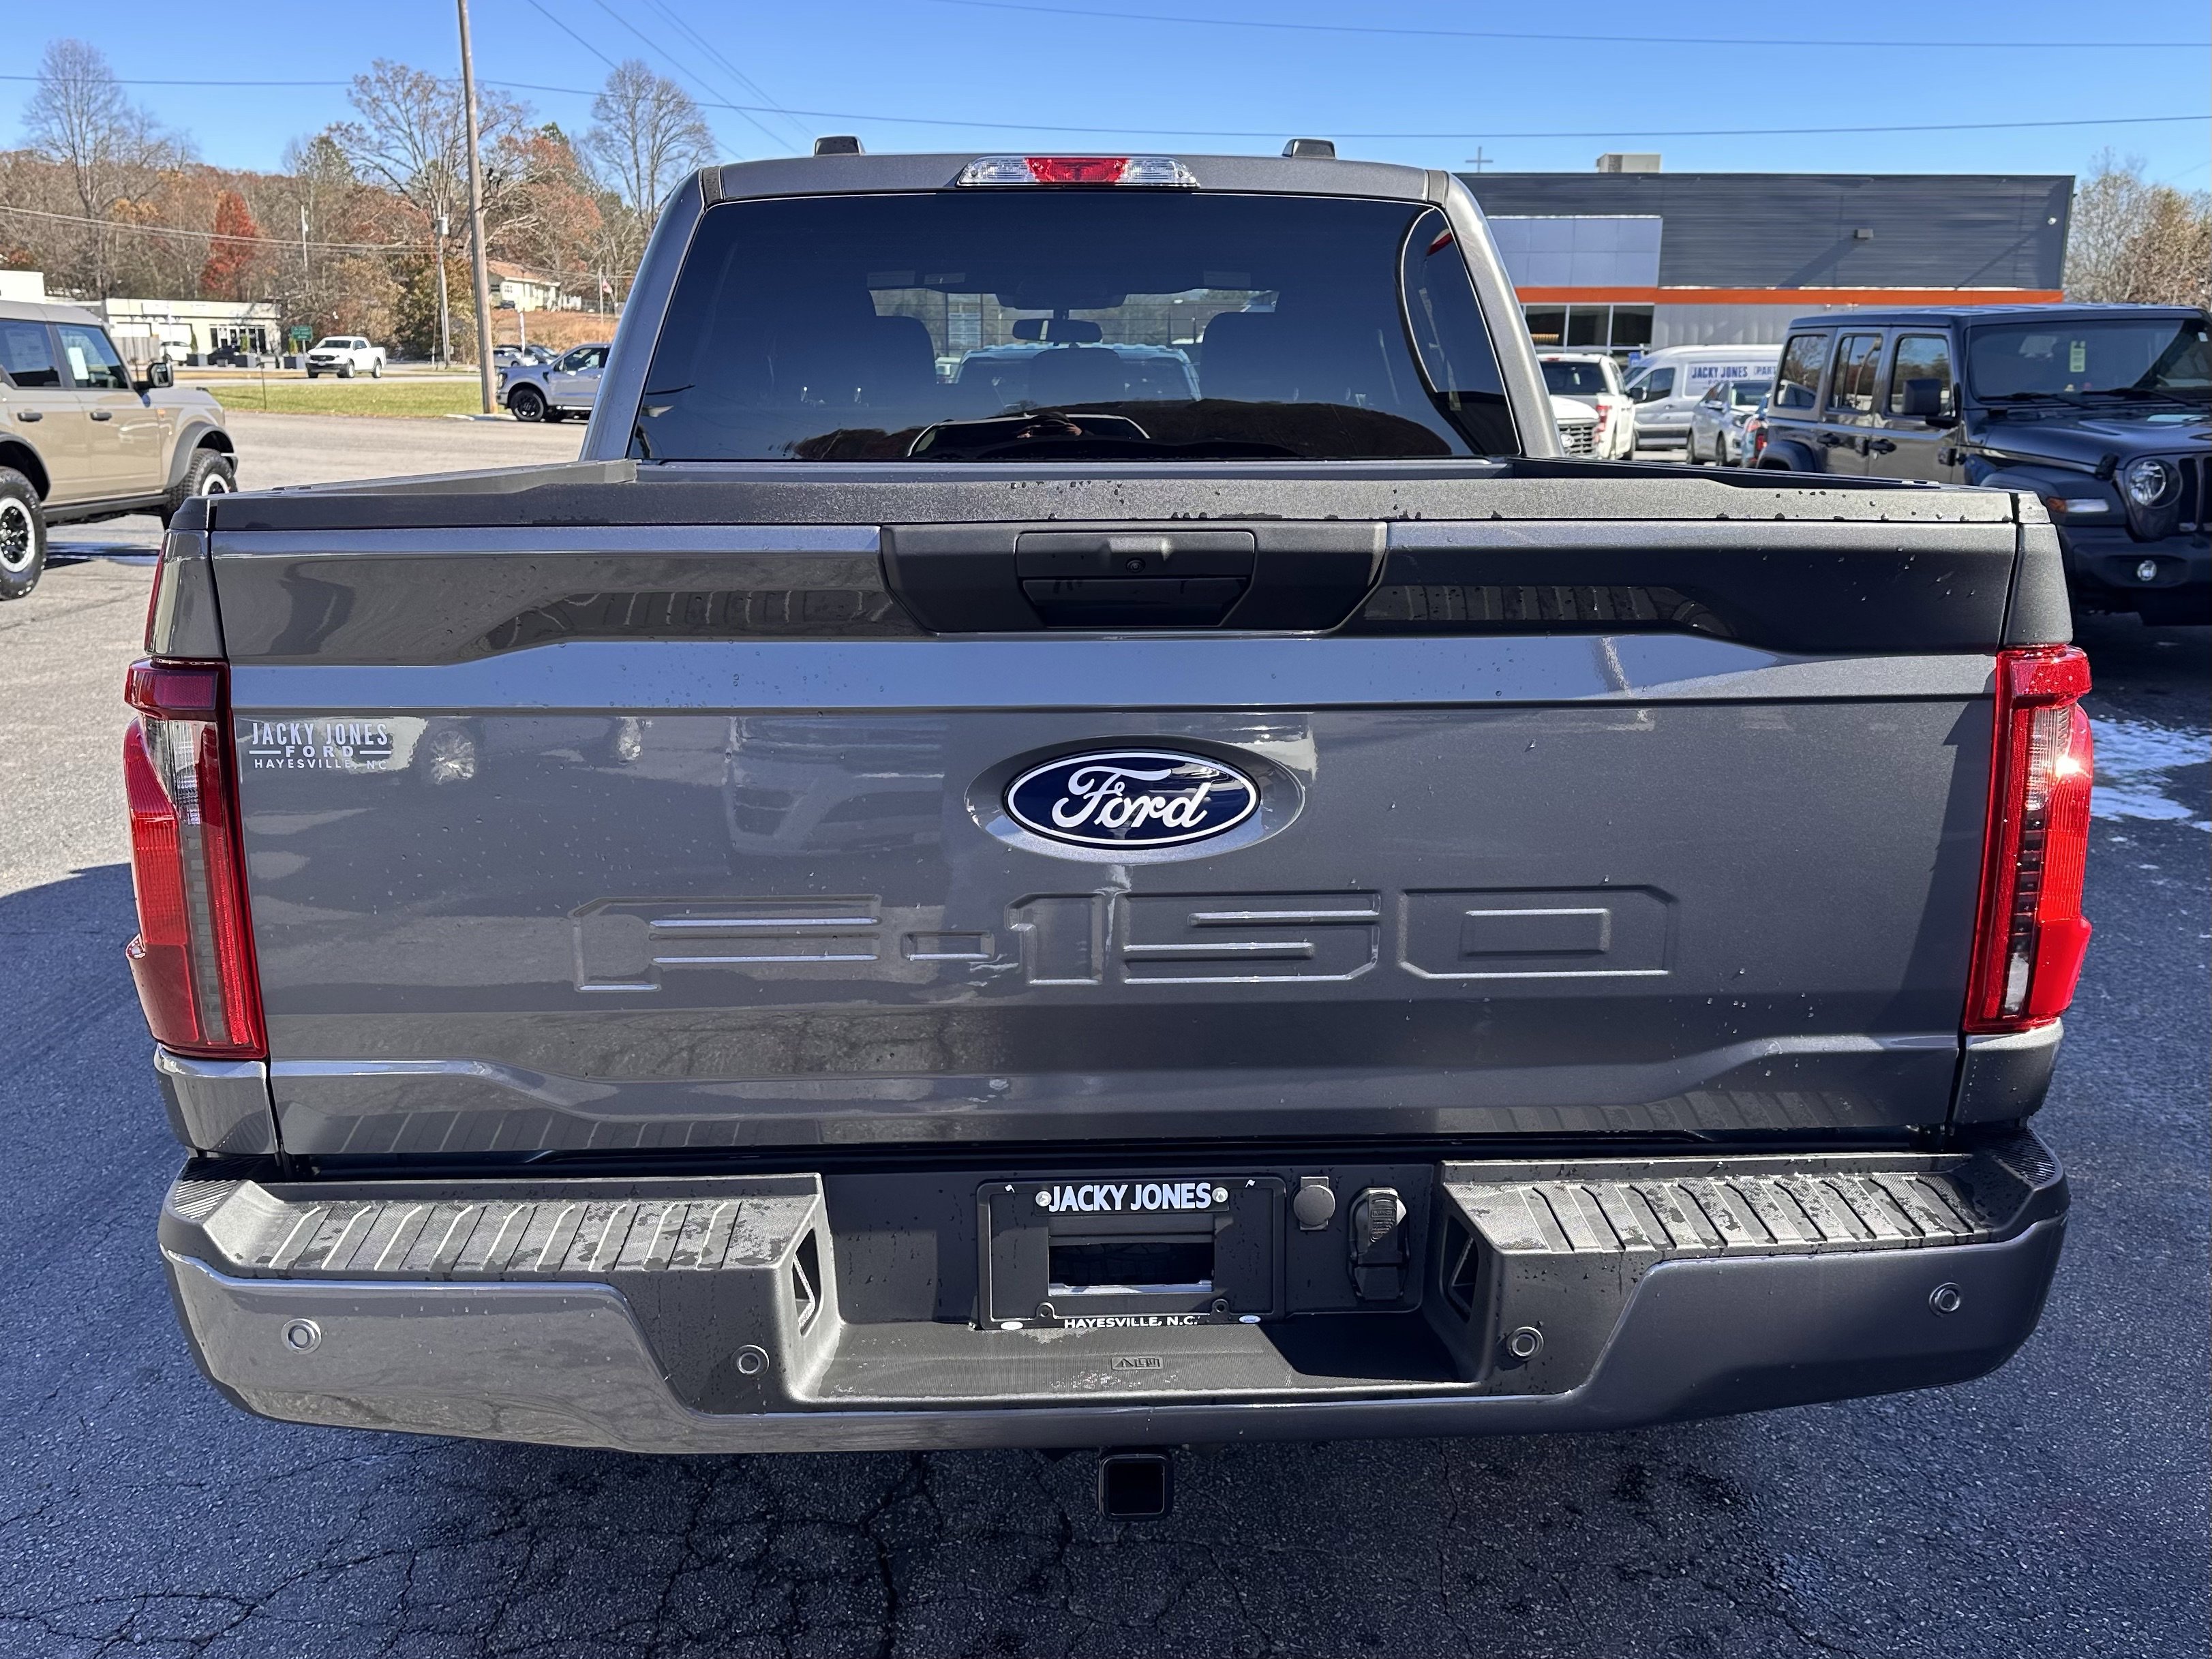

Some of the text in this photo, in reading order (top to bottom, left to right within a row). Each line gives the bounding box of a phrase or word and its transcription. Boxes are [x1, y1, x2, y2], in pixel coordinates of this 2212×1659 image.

[1692, 367, 1748, 378] JACKY JONES
[252, 722, 389, 746] JACKY JONES
[286, 746, 354, 758] FORD
[254, 759, 387, 770] HAYESVILLE, NC
[1052, 765, 1209, 829] Ford
[571, 885, 1678, 992] F-150
[1048, 1182, 1211, 1213] JACKY JONES
[1064, 1315, 1198, 1329] HAYESVILLE, N.C.
